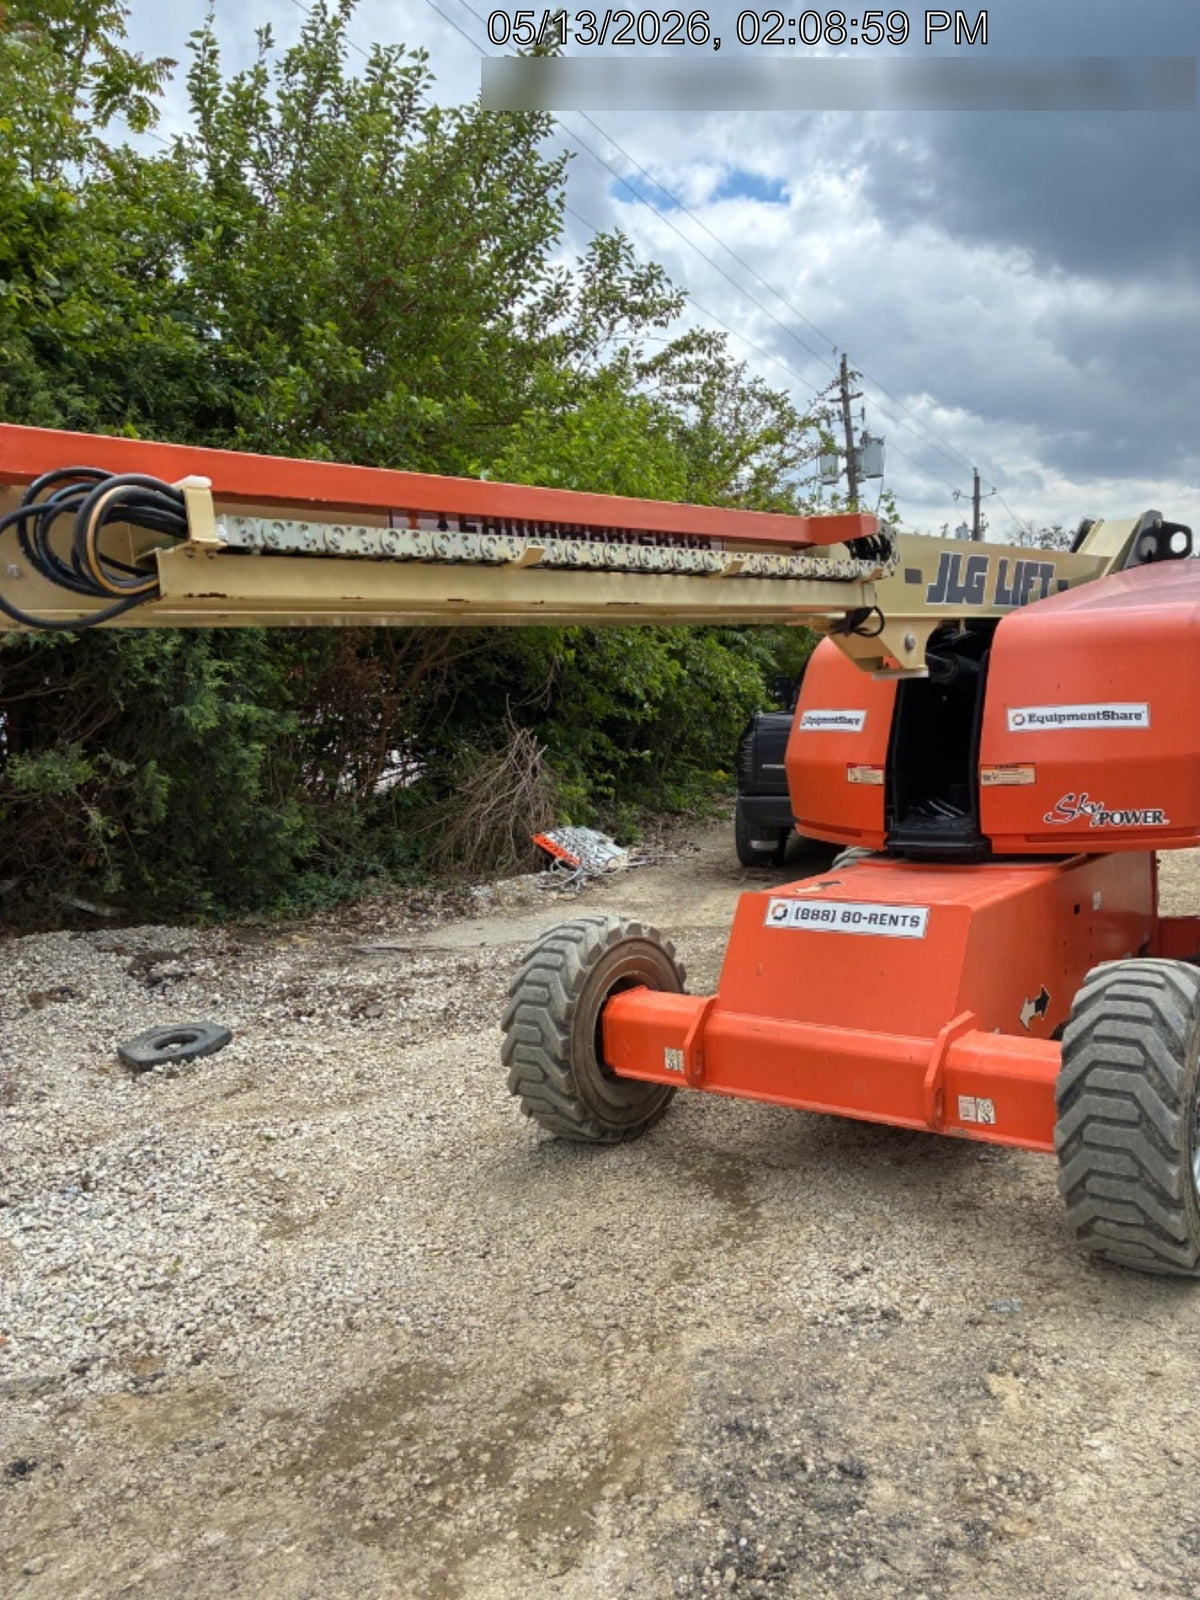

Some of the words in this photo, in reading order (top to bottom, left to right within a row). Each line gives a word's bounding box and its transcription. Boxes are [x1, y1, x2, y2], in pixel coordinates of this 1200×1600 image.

[925, 551, 989, 606] JLG
[992, 557, 1056, 607] LIFT
[1028, 710, 1143, 725] EquipmentShare
[1043, 792, 1104, 827] Sky
[1098, 809, 1165, 826] POWER
[794, 907, 837, 923] (888)
[840, 911, 921, 928] 80-RENTS
